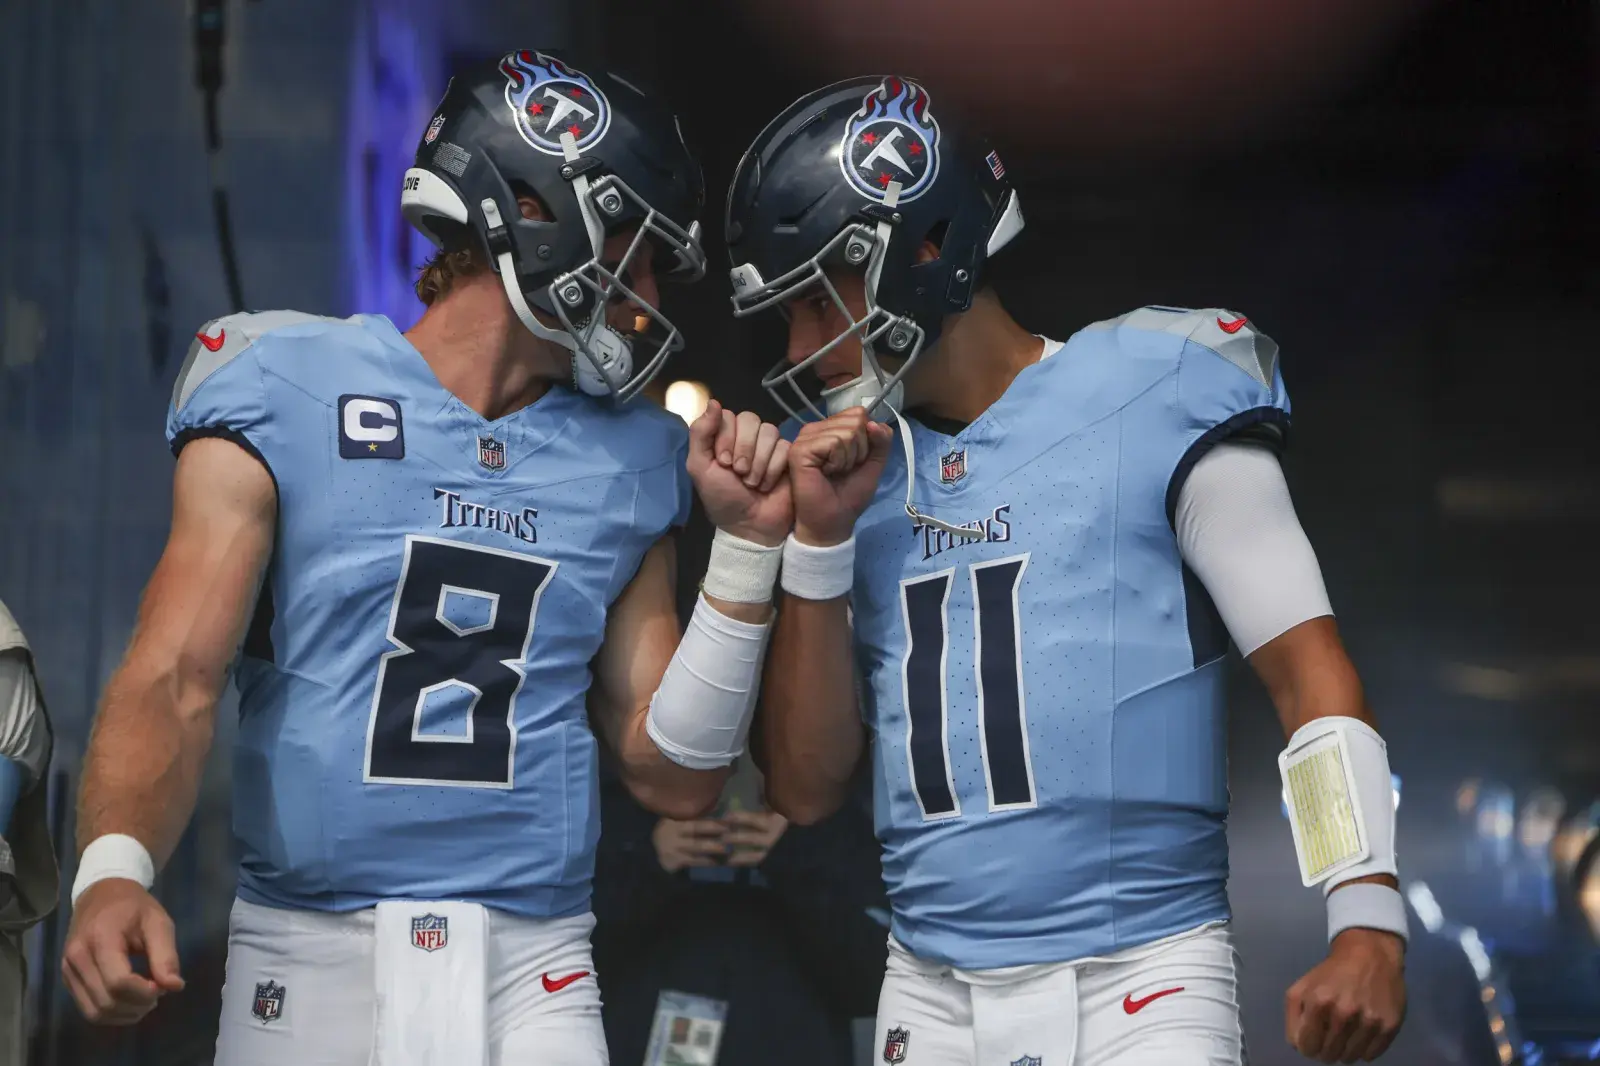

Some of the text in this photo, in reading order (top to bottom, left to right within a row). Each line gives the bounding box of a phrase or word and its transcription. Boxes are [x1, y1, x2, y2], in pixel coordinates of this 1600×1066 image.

[344, 398, 398, 442] C
[482, 449, 503, 466] NFL
[943, 461, 963, 478] NFL
[433, 487, 539, 544] TITANS
[363, 534, 559, 790] 8
[899, 552, 1038, 822] 11
[415, 930, 445, 949] NFL
[255, 999, 277, 1016] NFL
